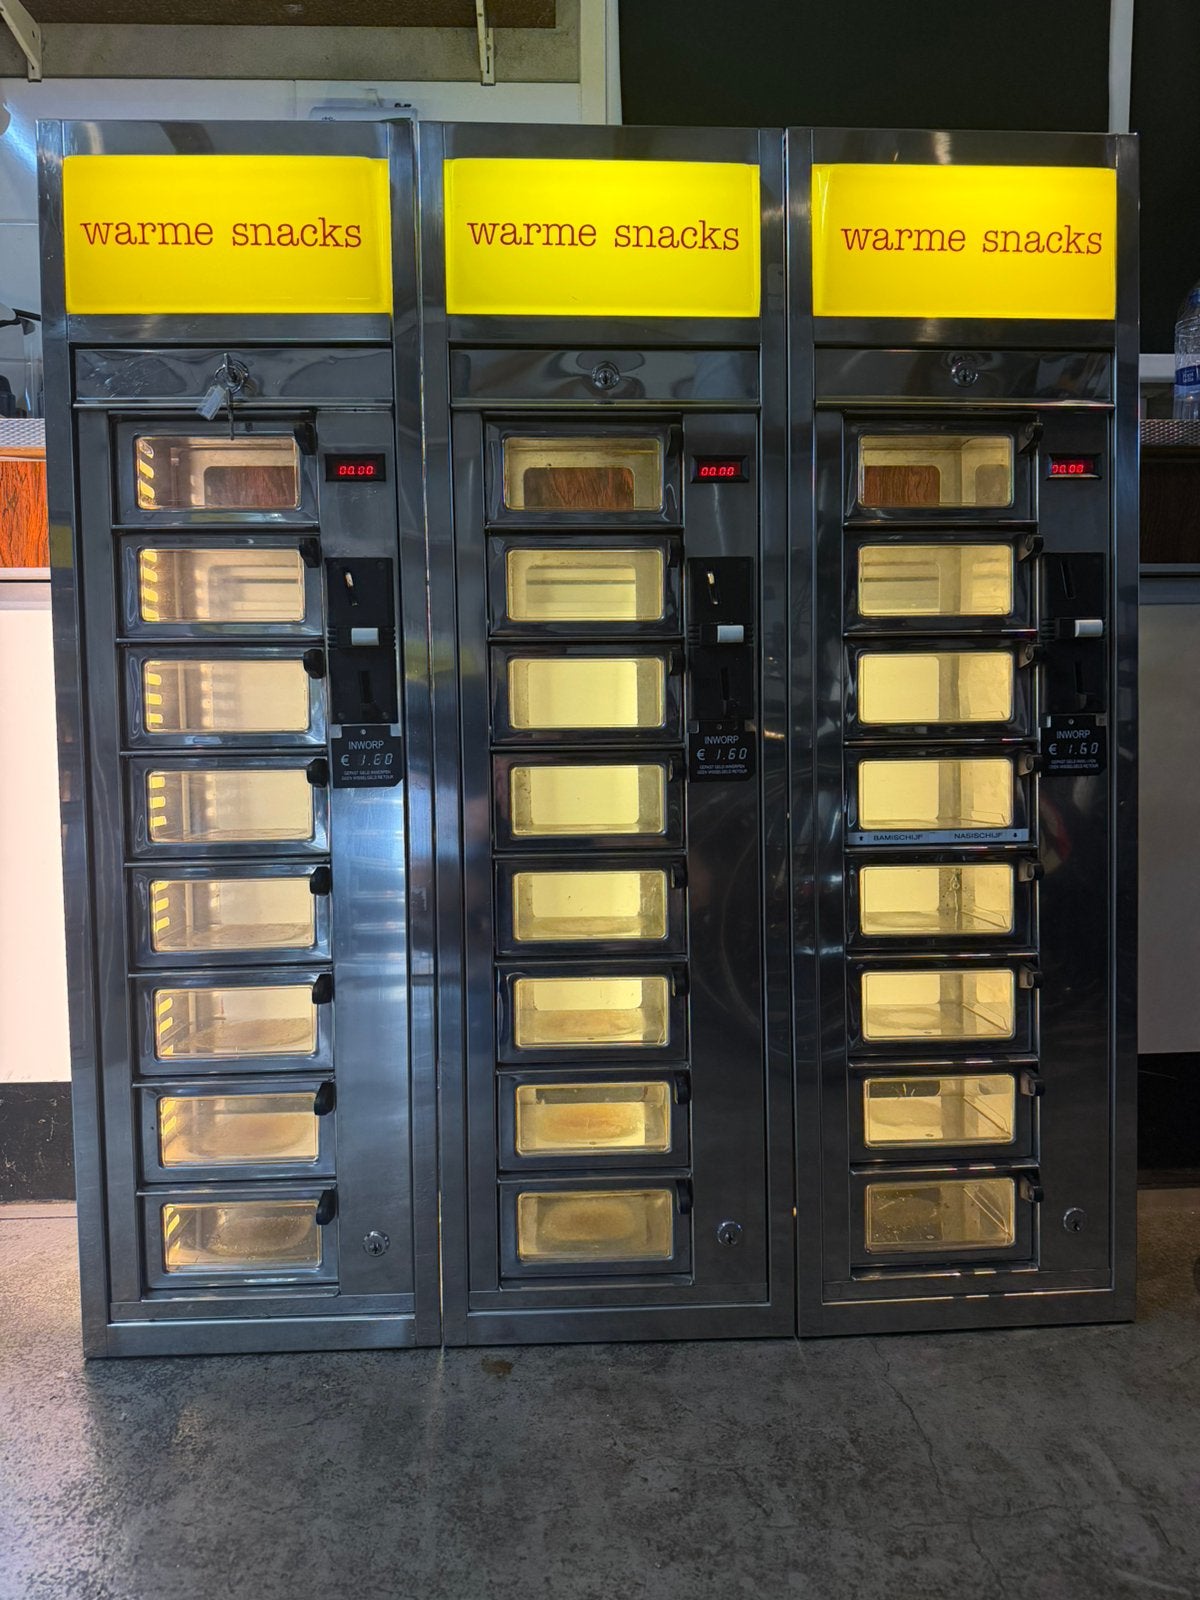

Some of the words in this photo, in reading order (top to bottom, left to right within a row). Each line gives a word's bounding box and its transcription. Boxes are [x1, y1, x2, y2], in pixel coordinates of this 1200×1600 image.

[80, 222, 213, 246] warme
[232, 217, 362, 249] snacks
[467, 222, 597, 247] warme
[614, 219, 739, 250] snacks
[841, 228, 966, 252] warme
[982, 224, 1103, 255] snacks
[704, 735, 740, 745] INWORP
[1056, 729, 1091, 739] INWORP
[348, 740, 384, 750] INWORP
[1048, 743, 1058, 755] €
[696, 748, 706, 761] €
[716, 747, 748, 760] 1.60
[340, 754, 350, 767] €
[873, 834, 923, 842] BAMISCHIJF
